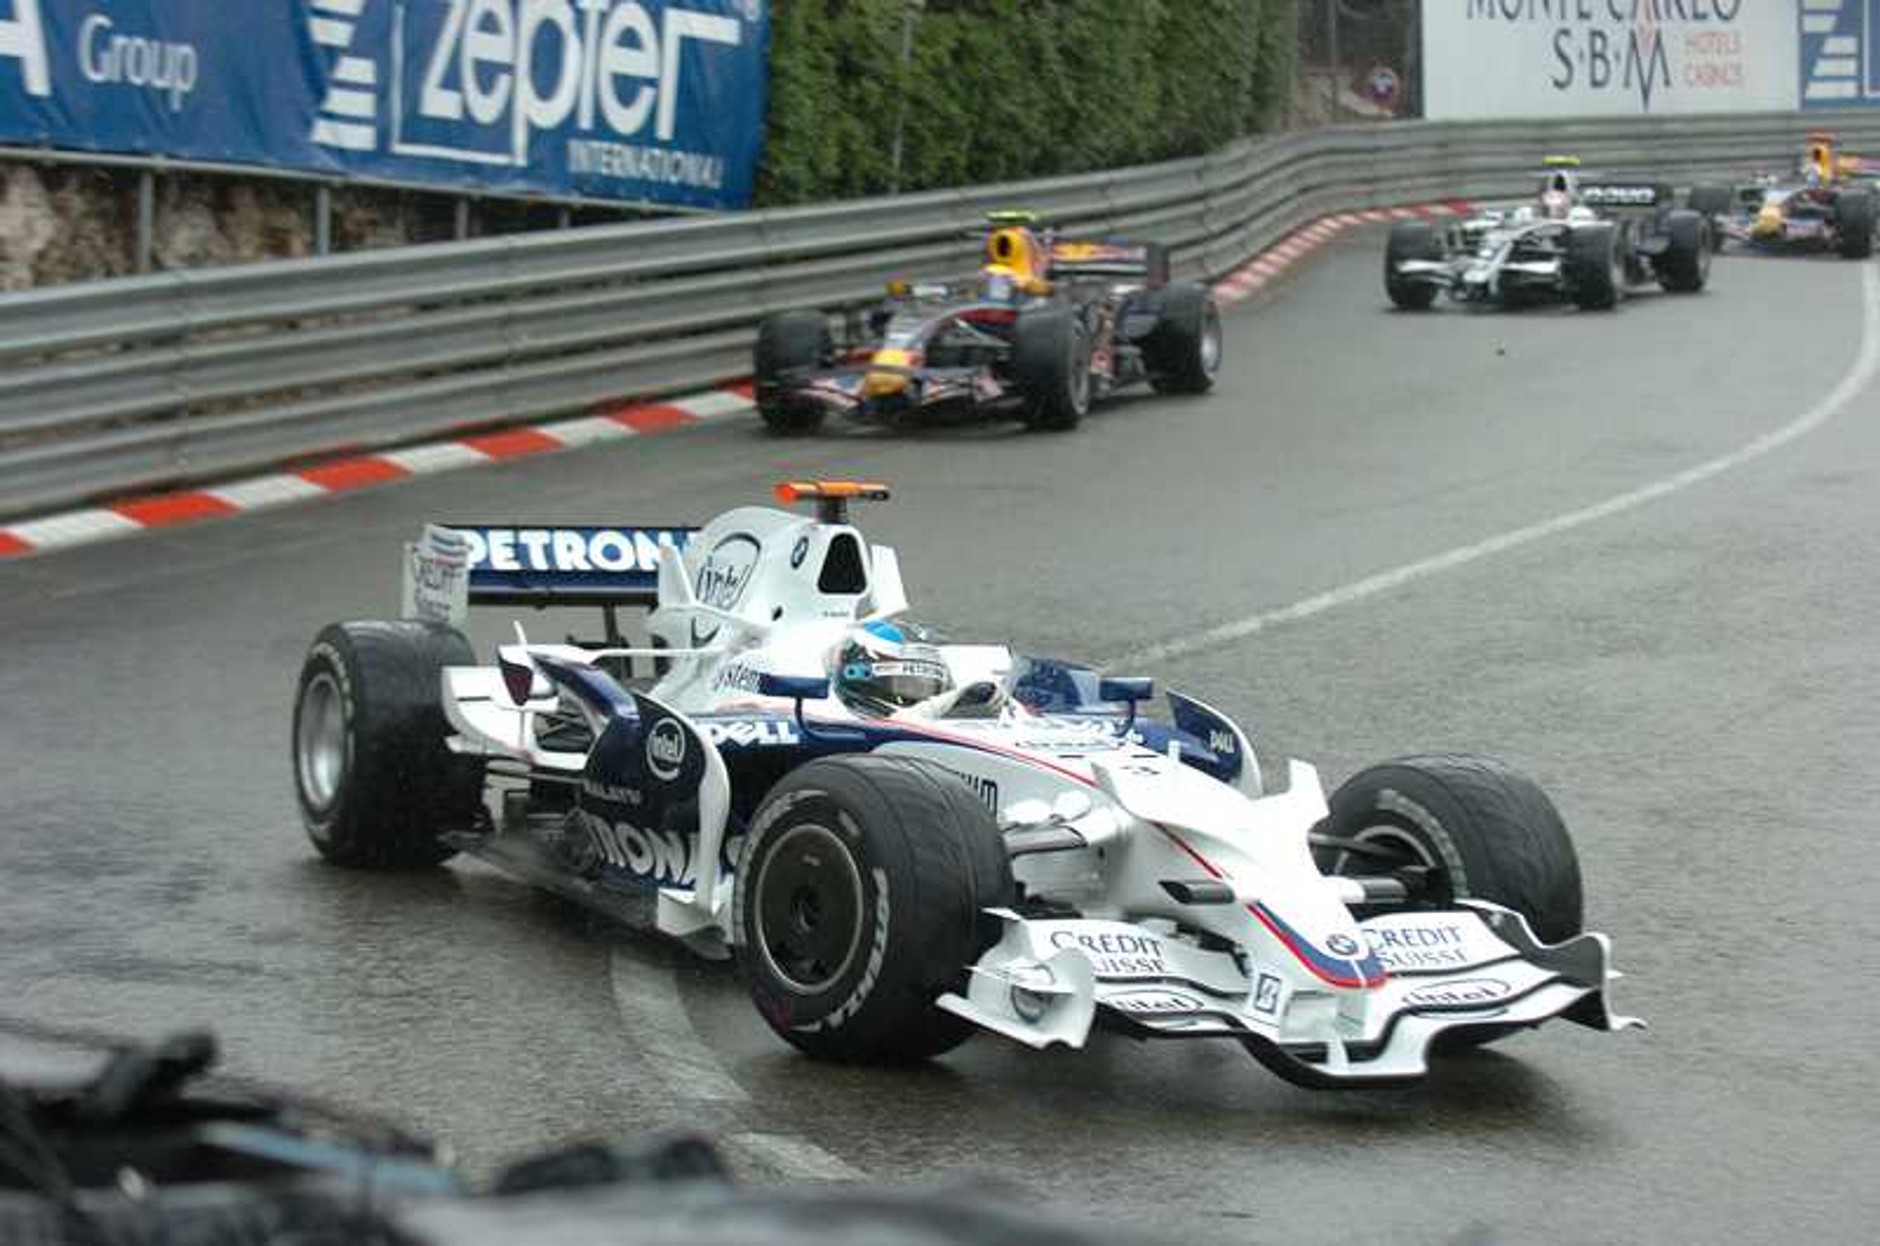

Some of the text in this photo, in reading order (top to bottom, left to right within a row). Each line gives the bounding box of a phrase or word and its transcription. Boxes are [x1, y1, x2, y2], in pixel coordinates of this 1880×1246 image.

[77, 13, 199, 112] Group
[464, 529, 697, 571] PETRON
[1051, 931, 1163, 957] CREDIT
[1361, 926, 1462, 950] CREDIT
